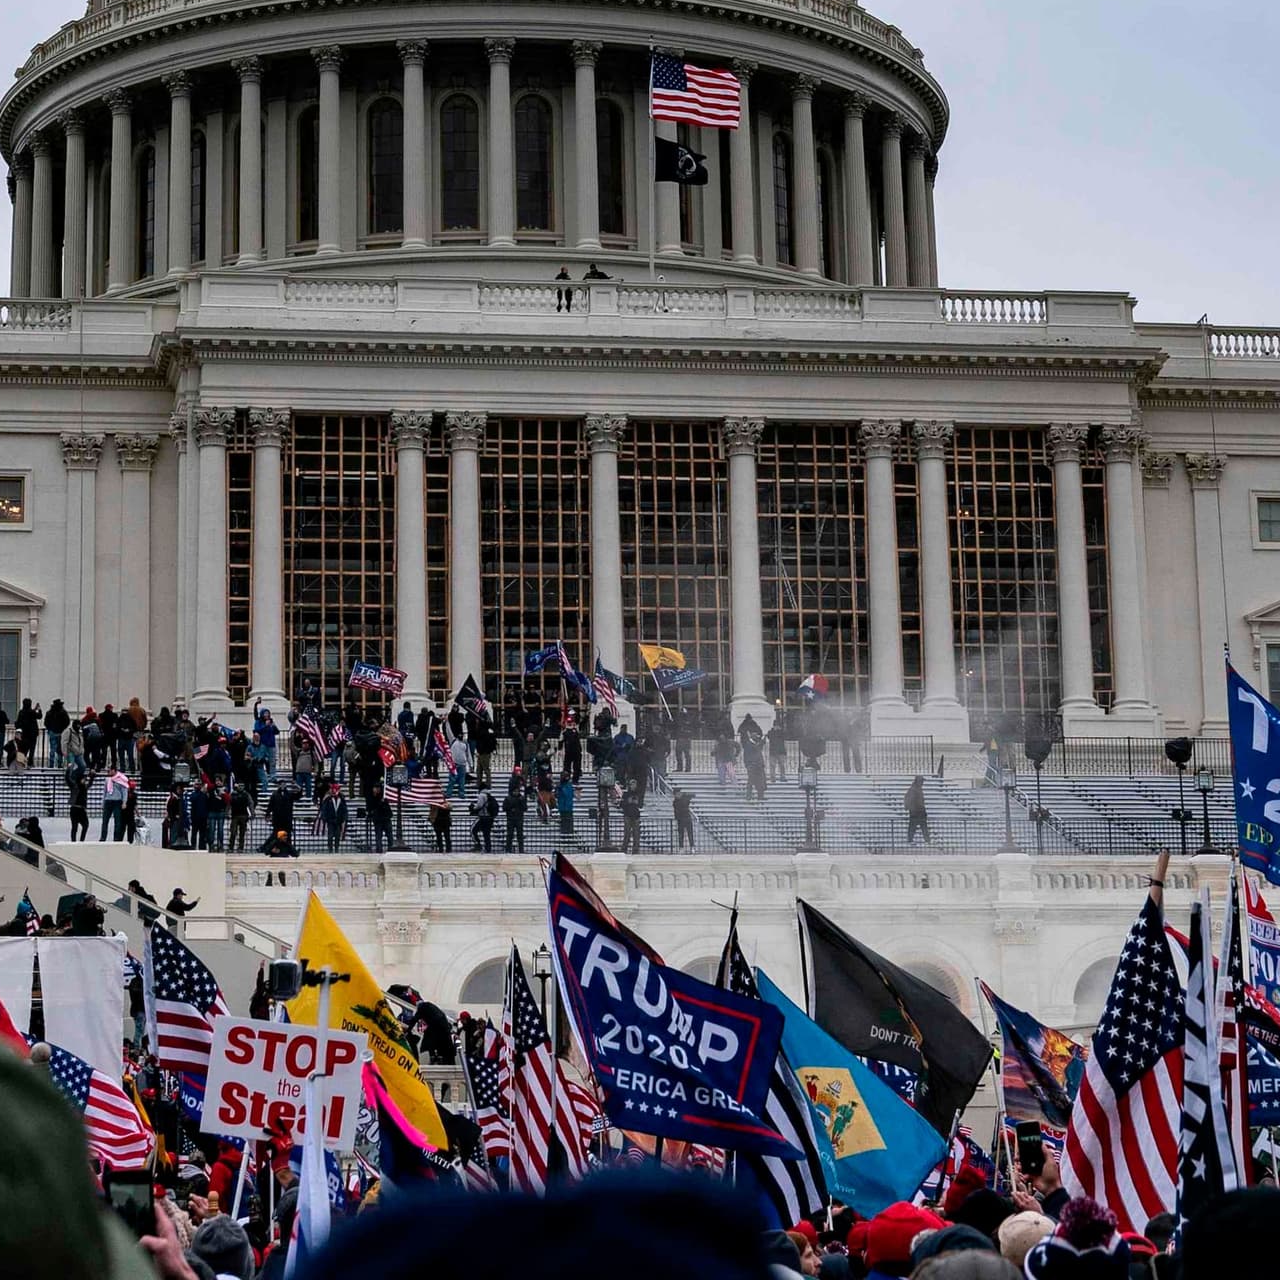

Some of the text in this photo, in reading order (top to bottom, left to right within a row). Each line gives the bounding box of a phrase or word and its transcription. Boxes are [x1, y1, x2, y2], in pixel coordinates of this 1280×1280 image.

[224, 1026, 357, 1078] STOP
[370, 1032, 396, 1061] TREAD
[397, 1055, 414, 1072] ON
[870, 1025, 900, 1044] DONT
[277, 1078, 302, 1098] the
[219, 1081, 345, 1138] Steal
